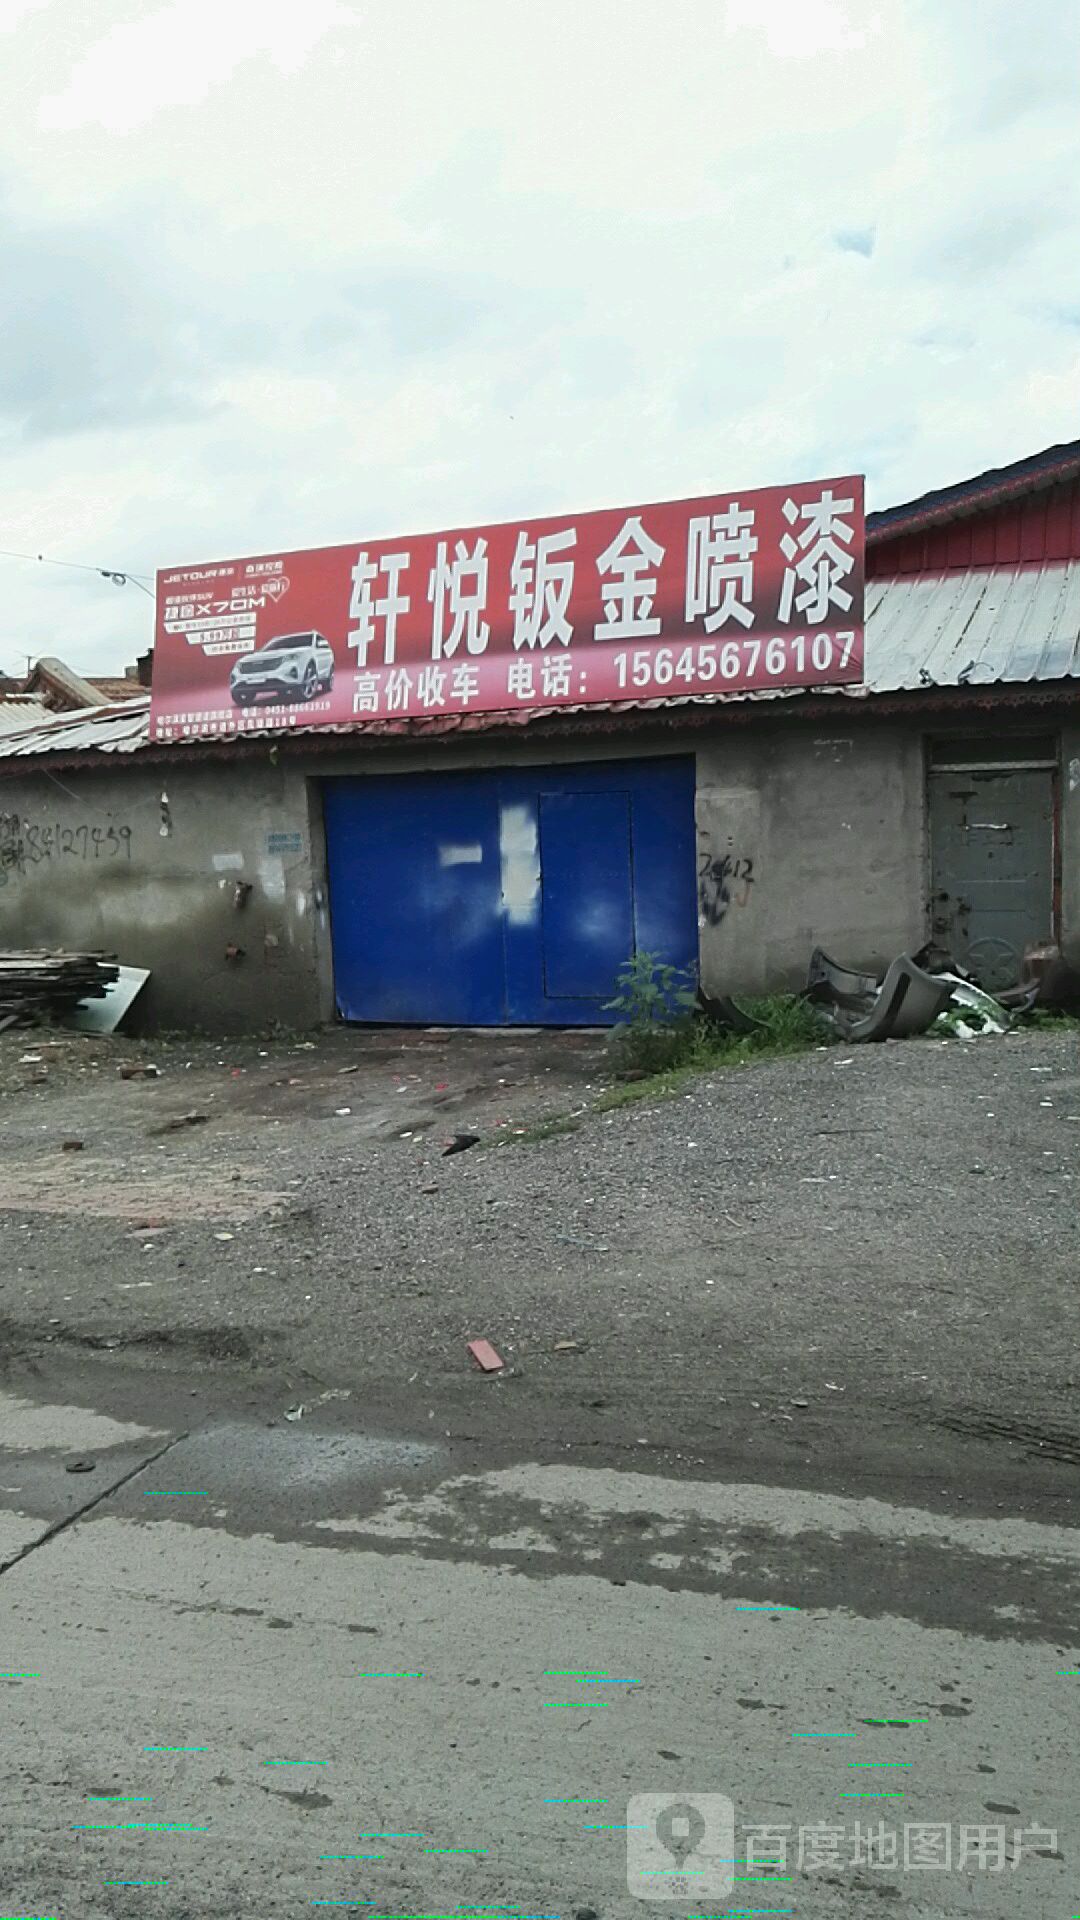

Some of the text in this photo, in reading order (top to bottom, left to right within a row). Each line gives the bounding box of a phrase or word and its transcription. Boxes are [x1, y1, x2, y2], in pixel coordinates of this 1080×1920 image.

[348, 489, 856, 667] 轩悦钣金喷漆
[352, 663, 480, 714] 高价收车
